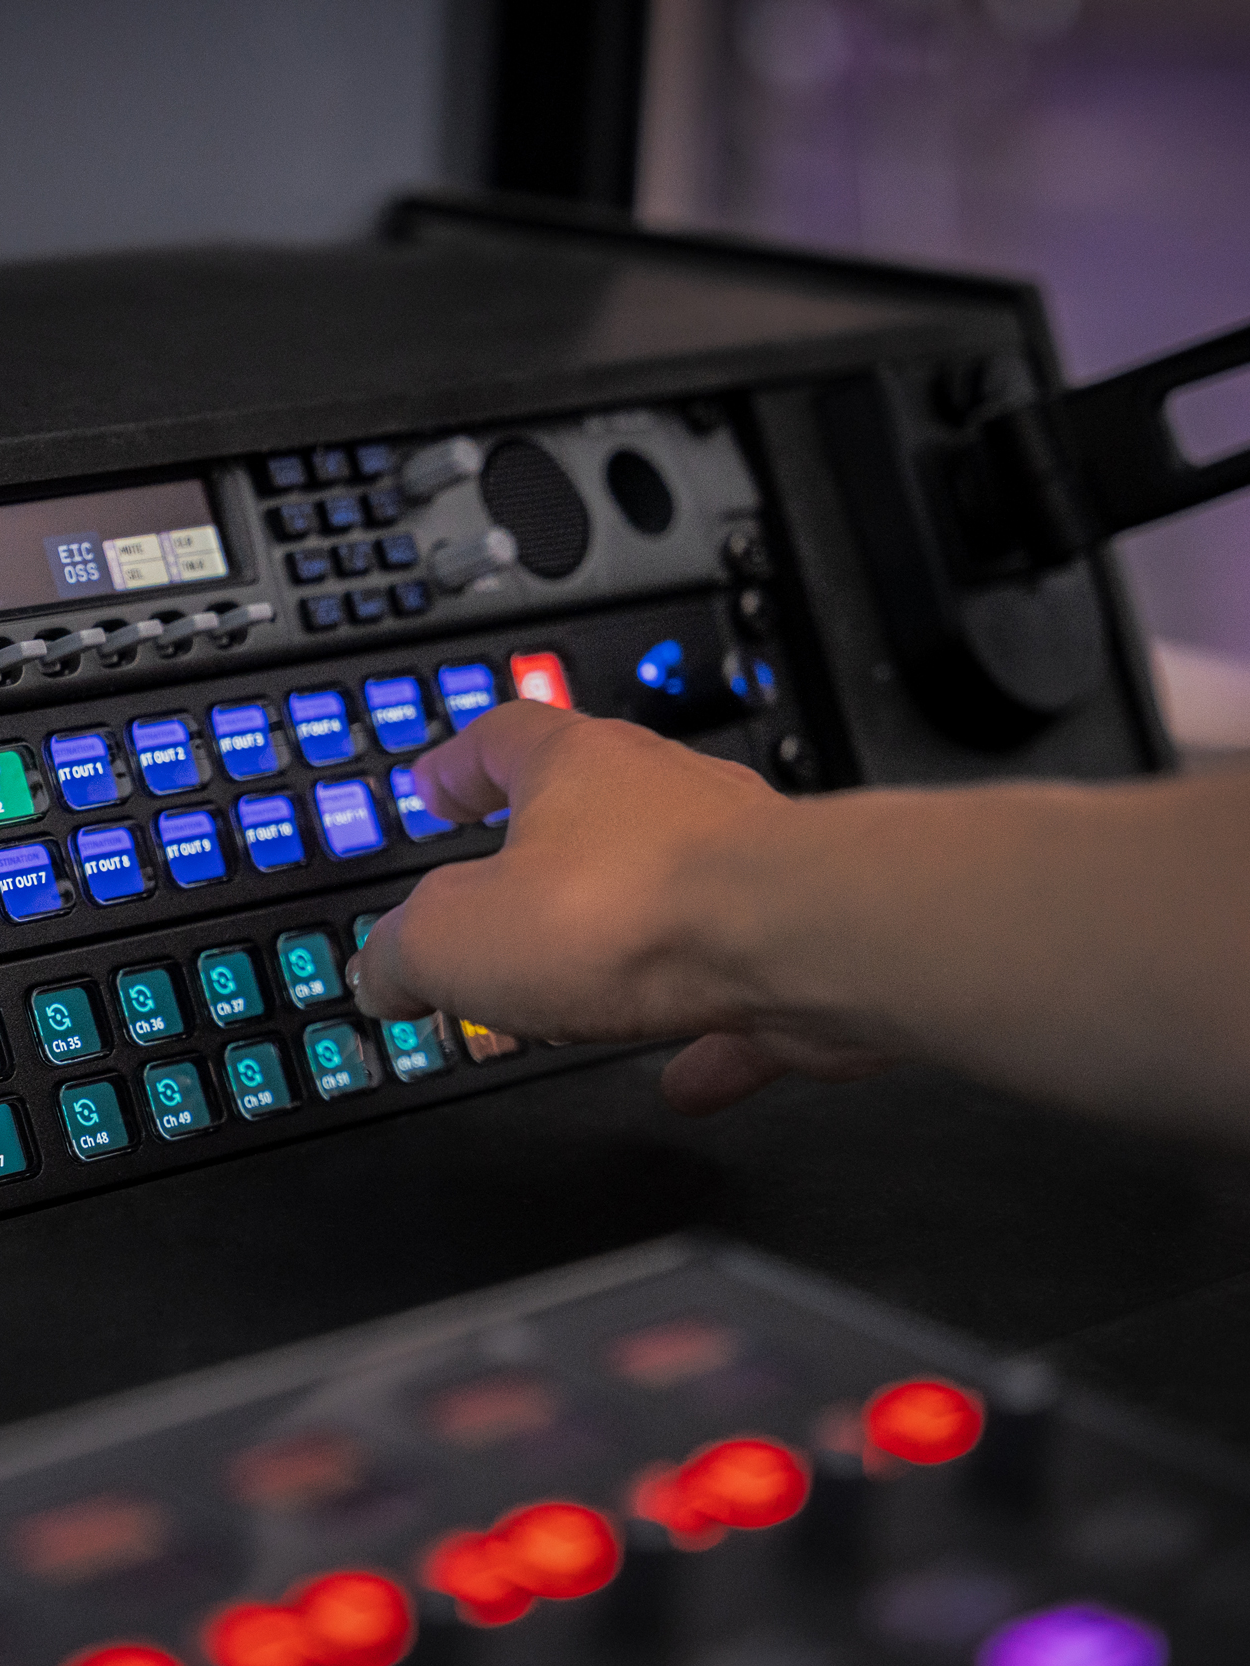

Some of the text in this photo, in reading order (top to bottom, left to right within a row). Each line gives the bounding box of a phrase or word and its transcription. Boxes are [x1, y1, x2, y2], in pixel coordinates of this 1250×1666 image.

[57, 541, 95, 564] EIC
[64, 562, 100, 584] OSS
[154, 748, 176, 764] OUT
[176, 746, 186, 760] 2
[72, 763, 94, 778] OUT
[95, 762, 104, 775] 1
[98, 856, 121, 872] OUT
[121, 854, 131, 867] 8
[15, 873, 38, 888] OUT
[38, 871, 46, 884] 7
[216, 998, 245, 1016] Ch 37
[135, 1016, 165, 1034] Ch 36
[52, 1036, 82, 1053] Ch 35
[243, 1089, 273, 1109] Ch 50
[163, 1110, 192, 1129] Ch 49
[80, 1131, 110, 1149] Ch 48
